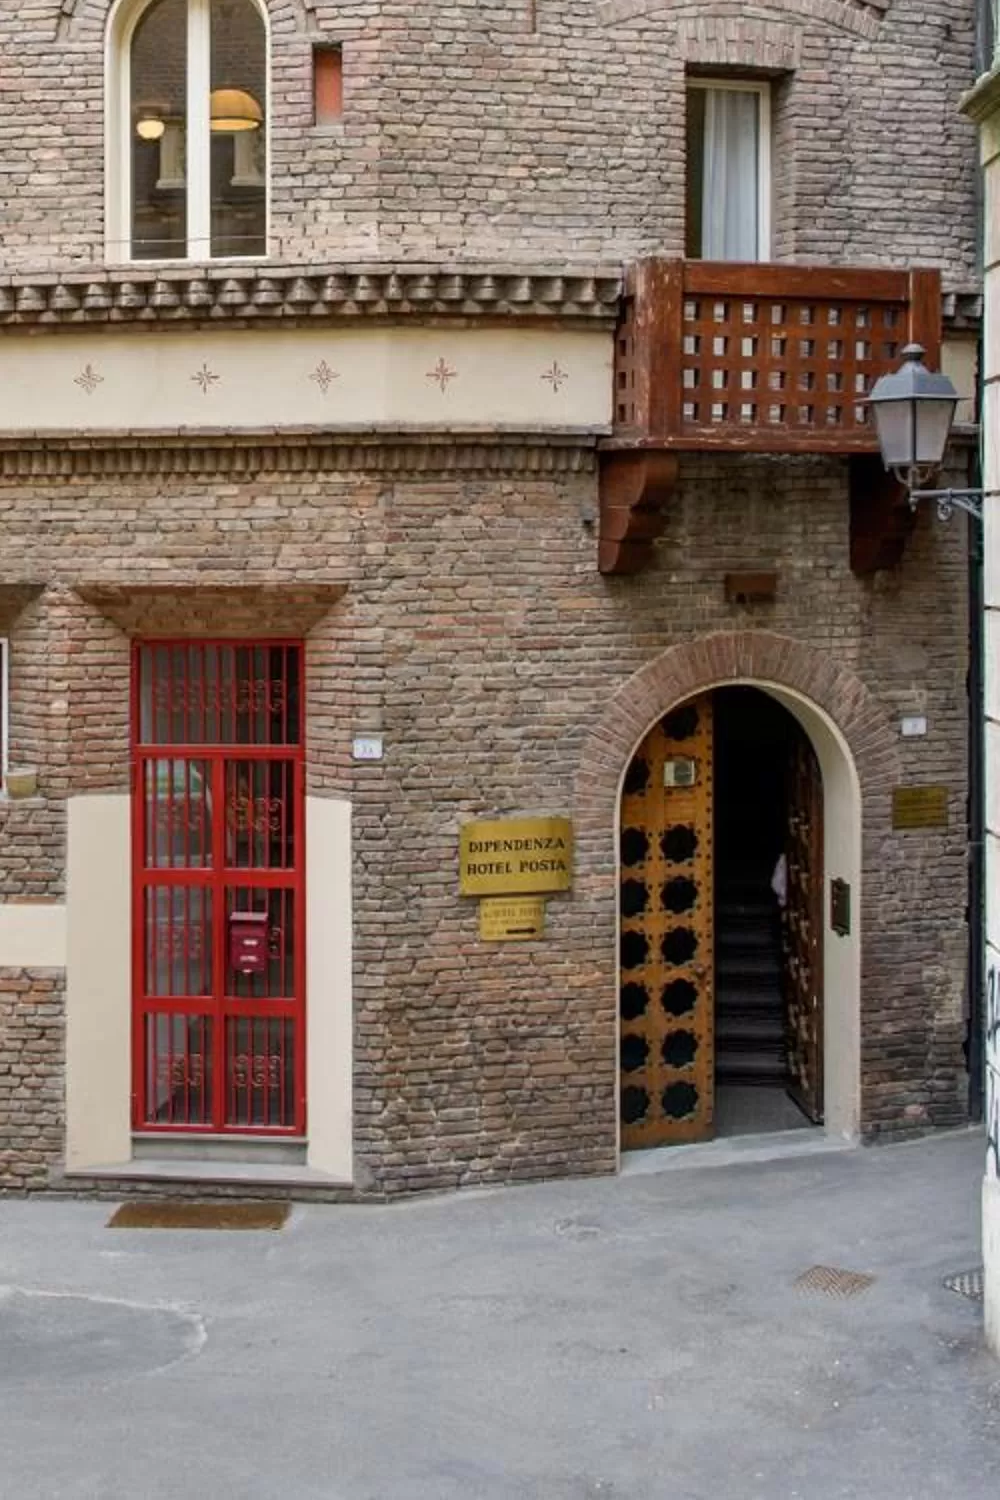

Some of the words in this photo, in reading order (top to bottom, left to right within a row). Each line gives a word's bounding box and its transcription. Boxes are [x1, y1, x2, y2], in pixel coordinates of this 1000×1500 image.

[468, 837, 565, 853] DIPENDENZA
[467, 862, 512, 875] HOTEL
[519, 859, 567, 873] POSTA
